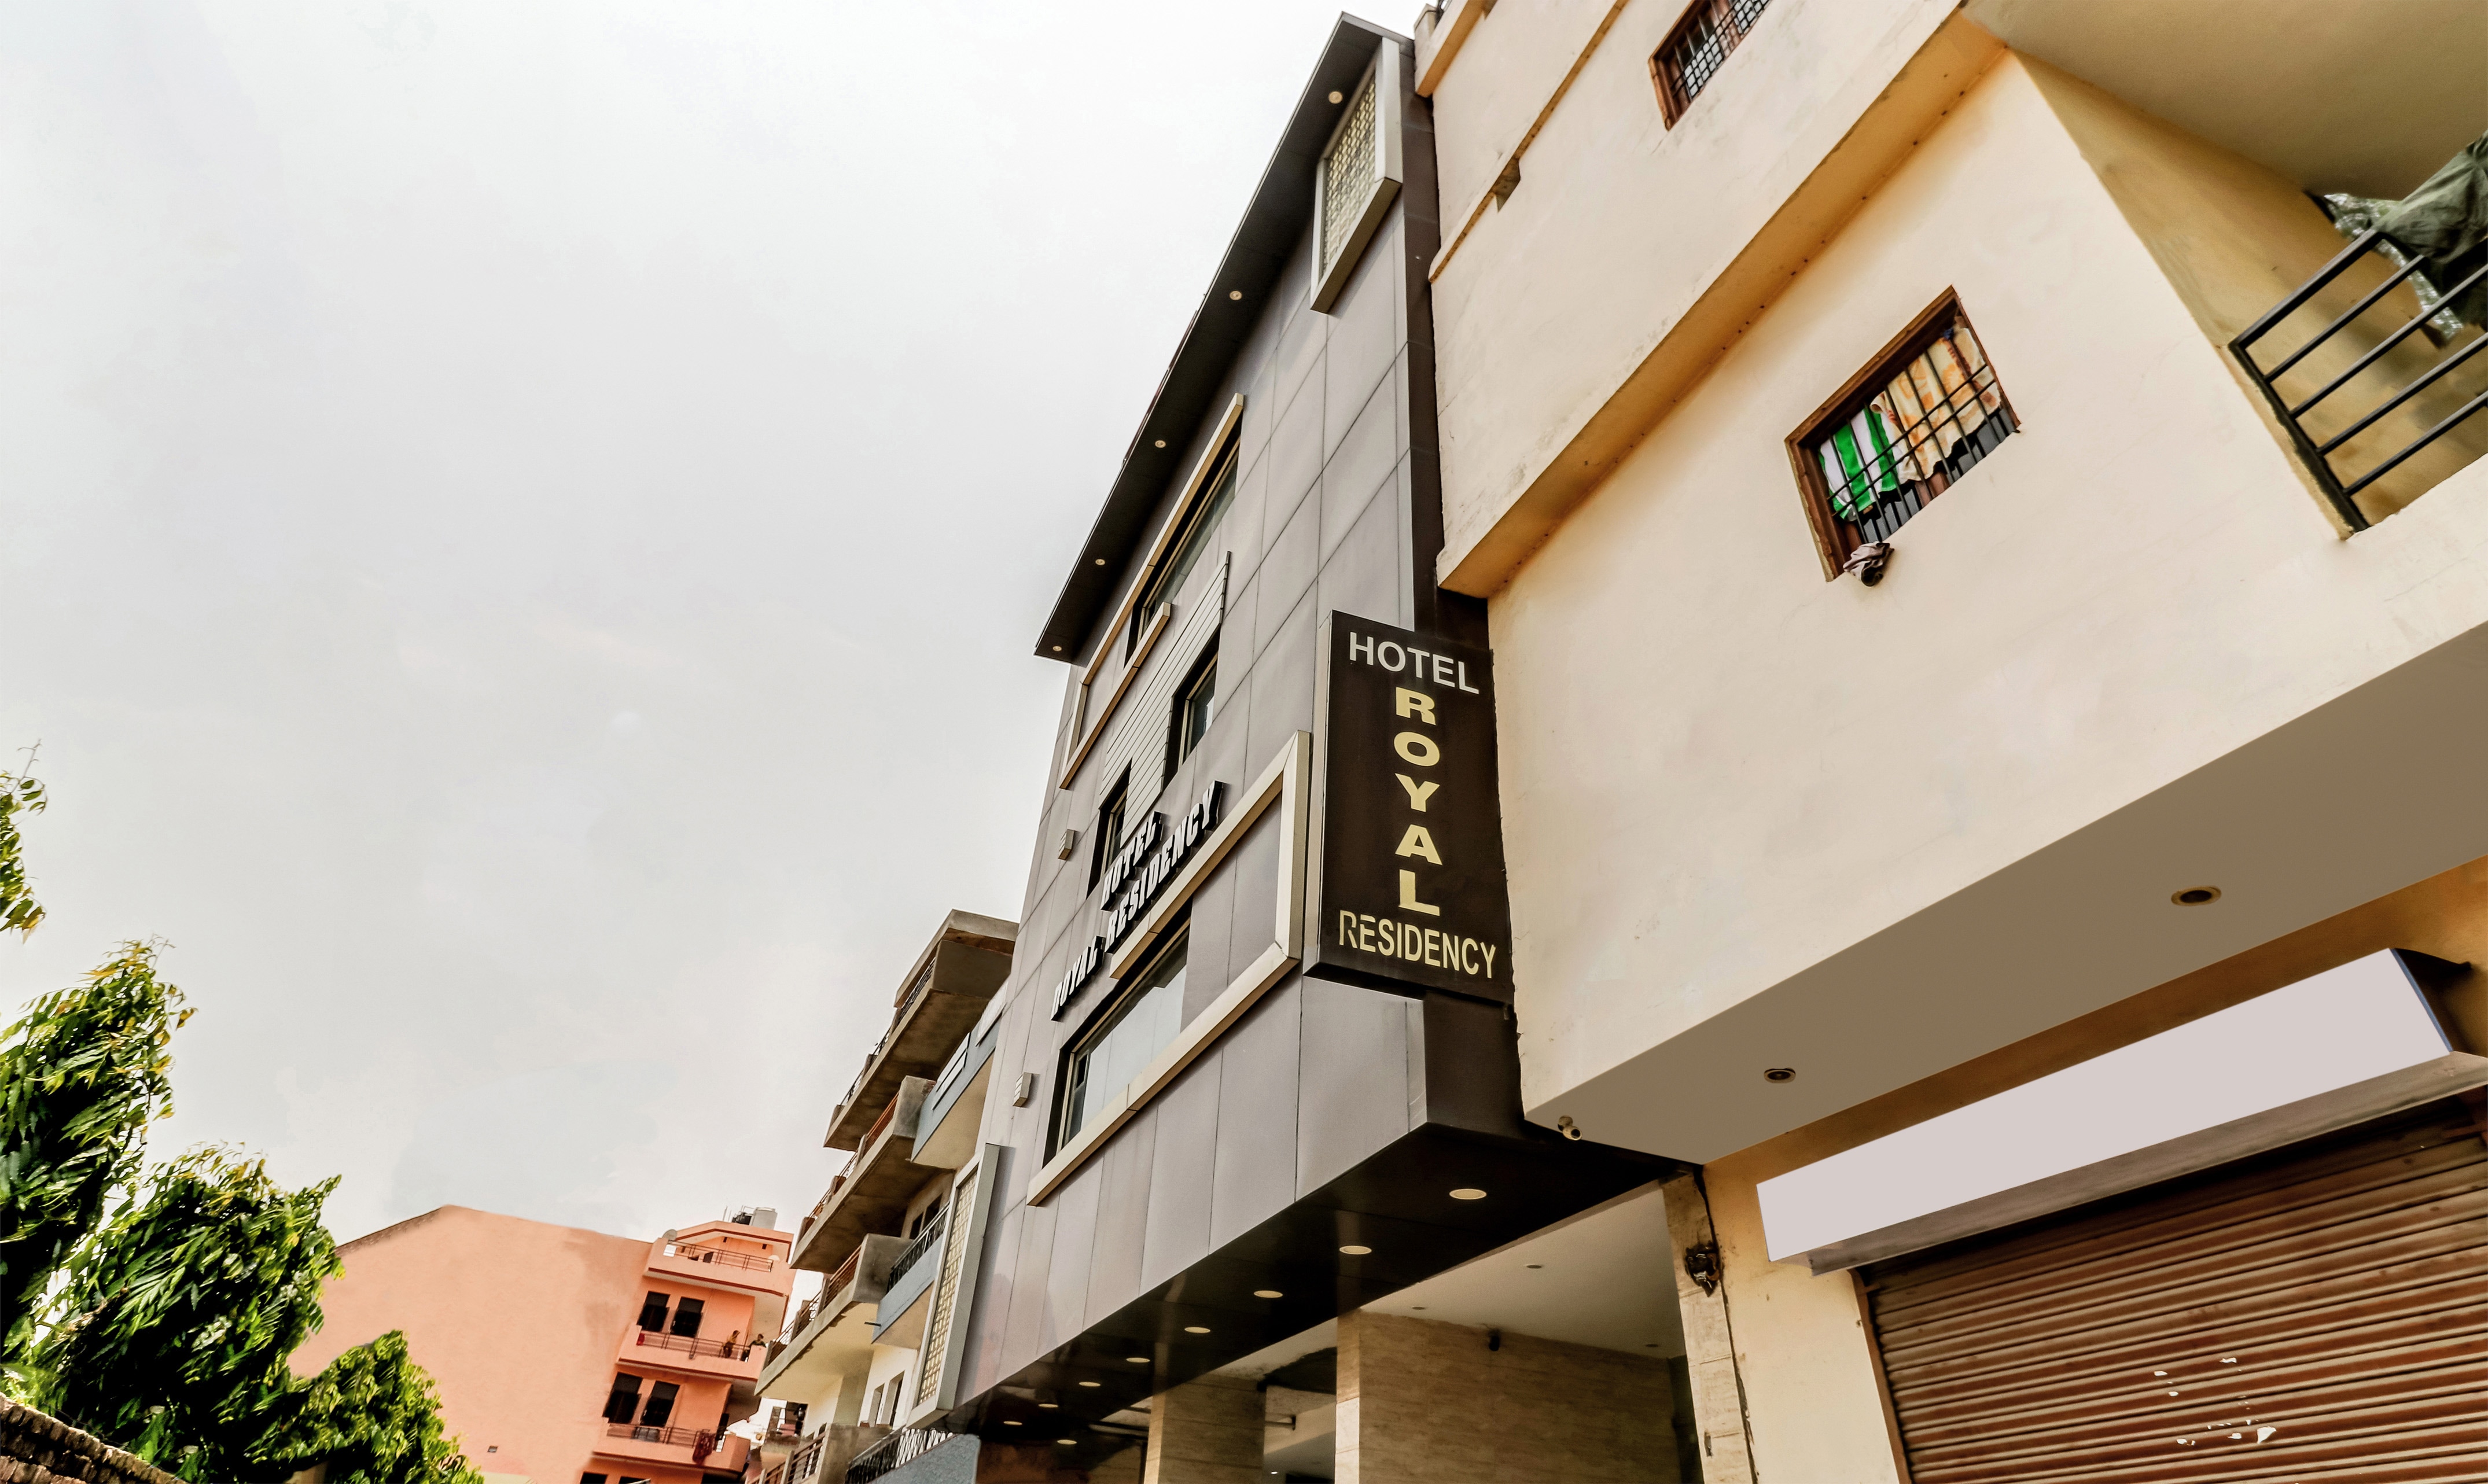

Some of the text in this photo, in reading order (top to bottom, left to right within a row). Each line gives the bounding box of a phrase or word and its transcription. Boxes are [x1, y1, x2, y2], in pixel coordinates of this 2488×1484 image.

[1349, 632, 1479, 694] HOTEL
[1394, 687, 1442, 916] ROYAL
[1051, 780, 1223, 1021] ROYAL RESIDENCY
[1101, 811, 1163, 910] HOTEL
[1339, 910, 1496, 978] RESIDENCY
